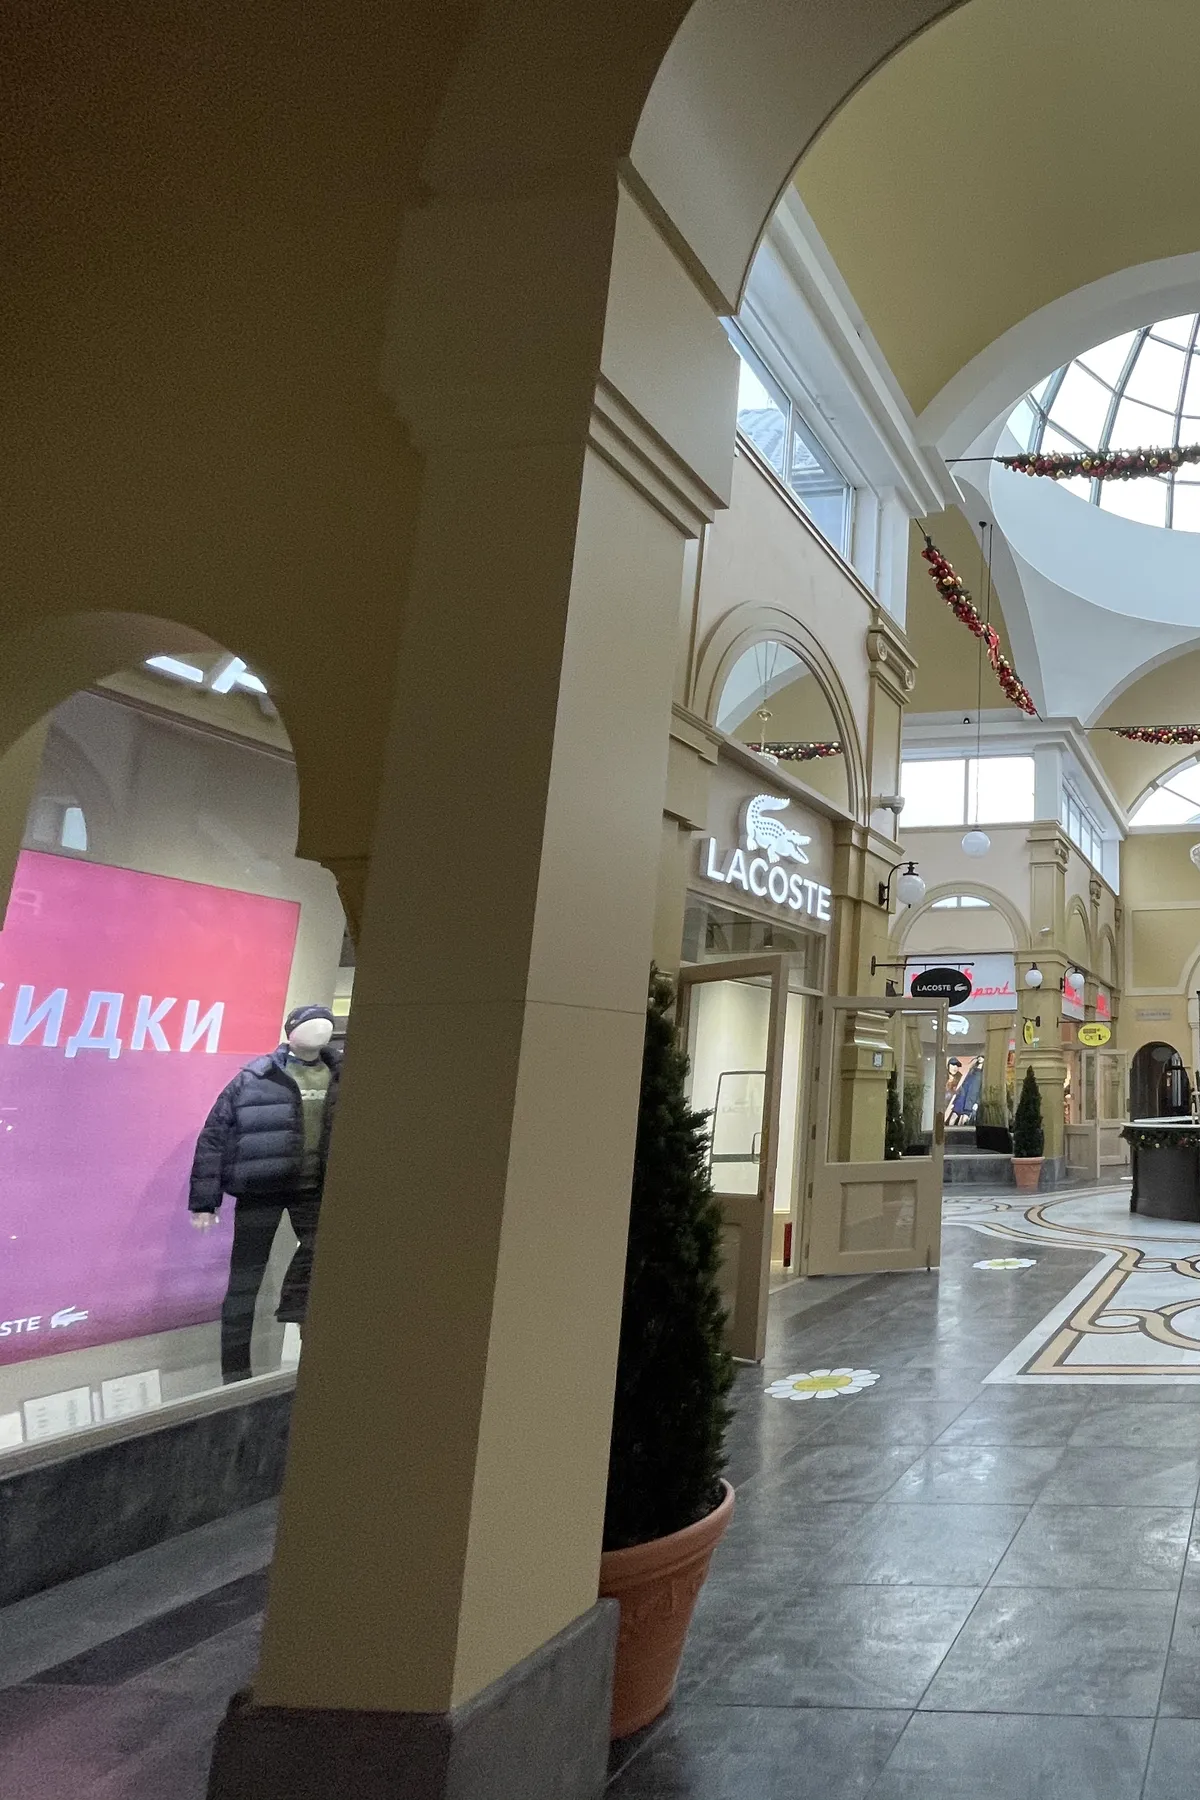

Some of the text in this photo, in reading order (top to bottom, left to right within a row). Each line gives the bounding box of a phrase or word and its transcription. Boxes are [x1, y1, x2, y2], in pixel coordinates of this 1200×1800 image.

[707, 837, 831, 921] LACOSTE
[0, 978, 225, 1060] ИДКИ
[916, 984, 952, 992] LACOSTE
